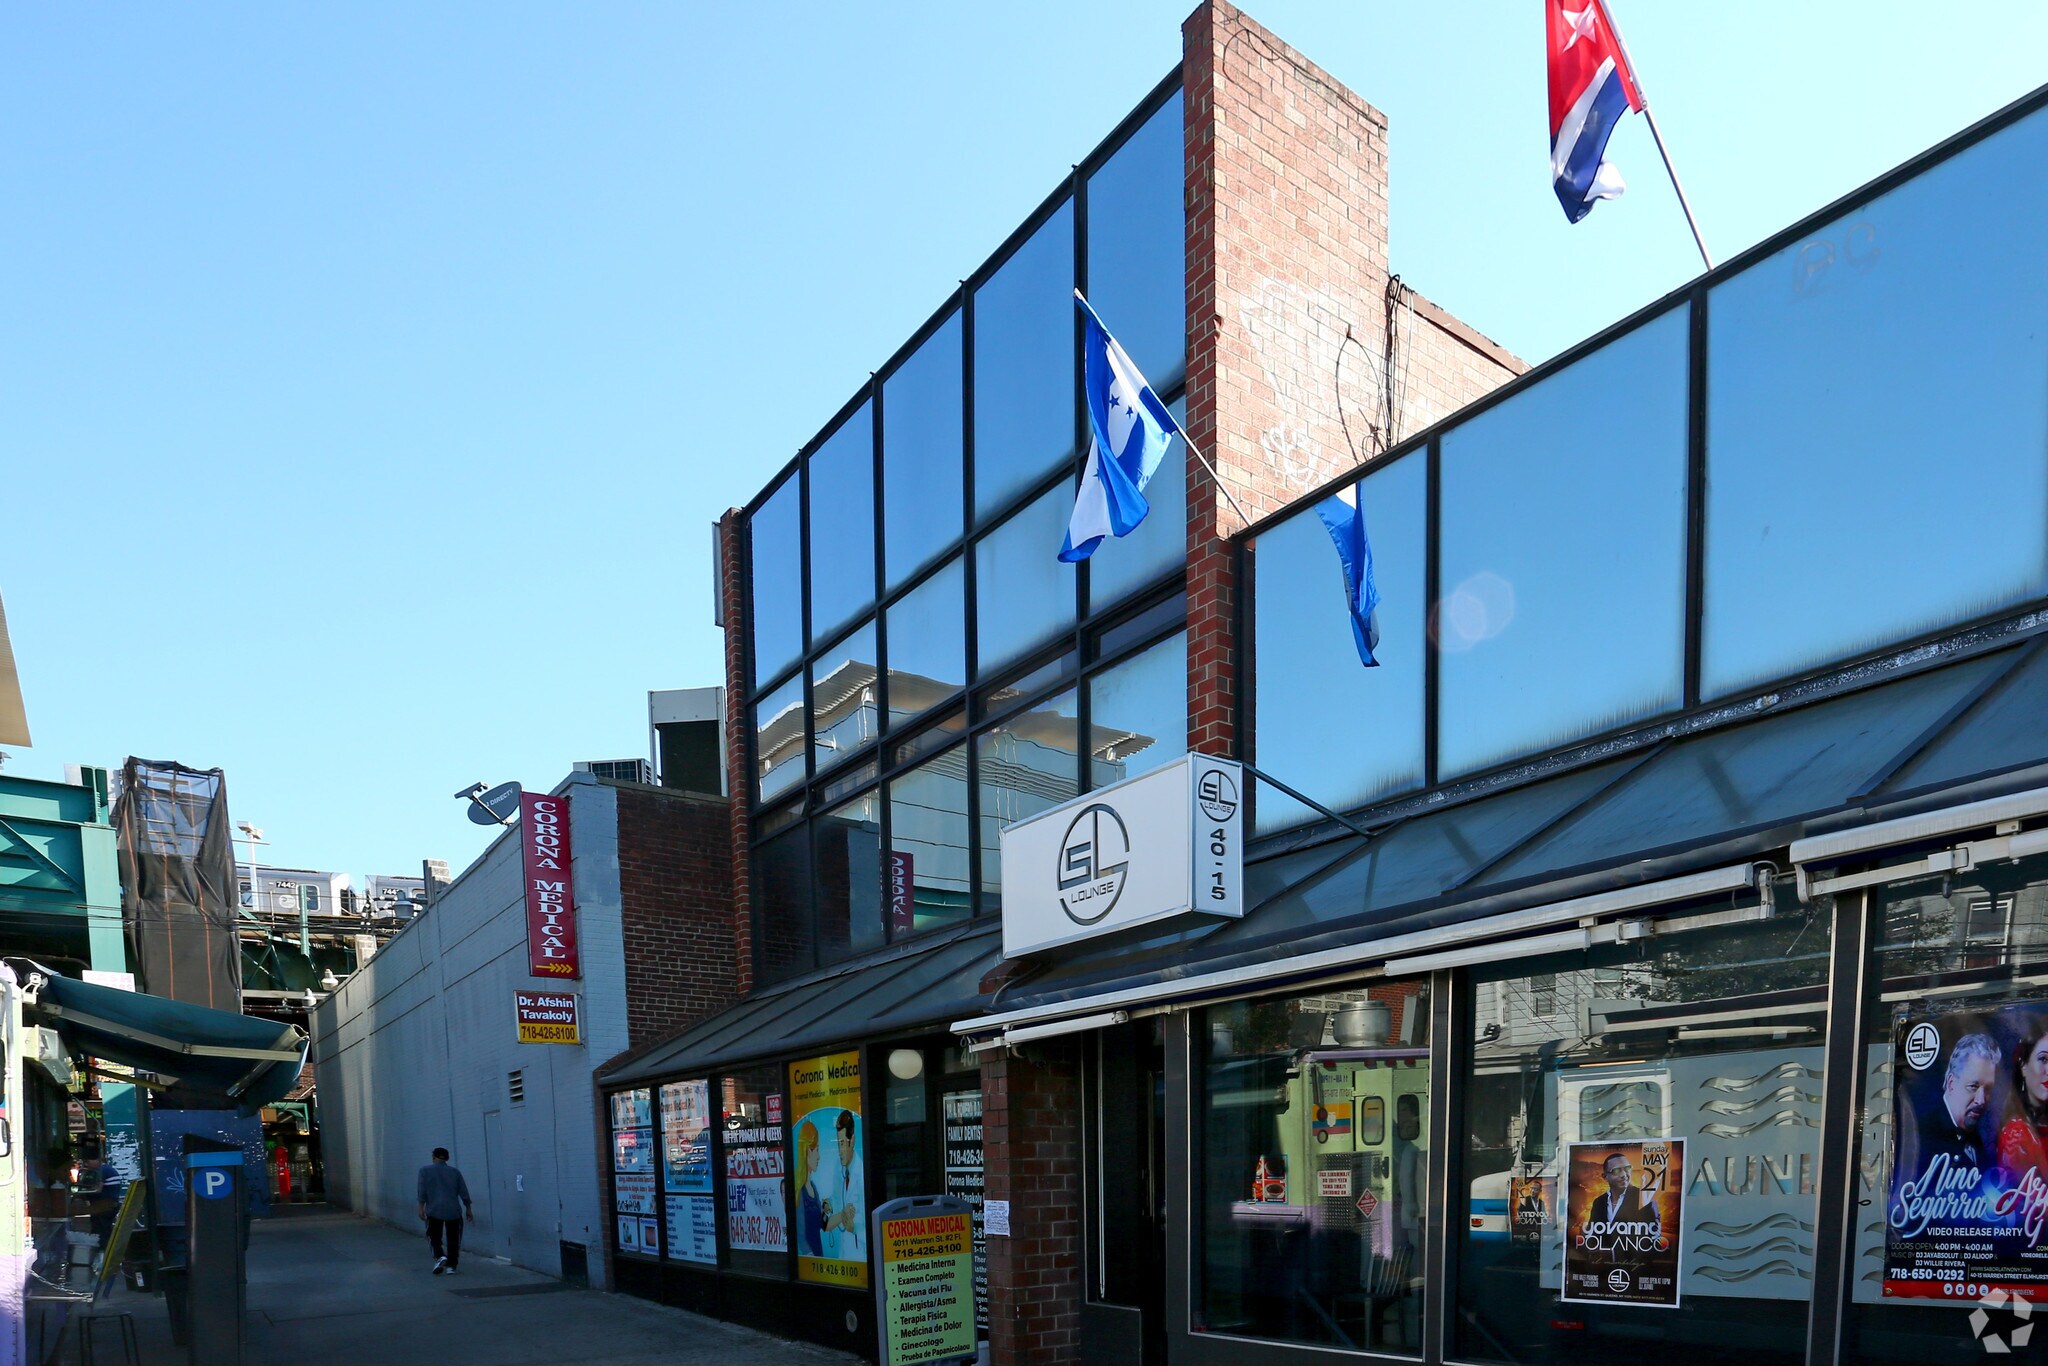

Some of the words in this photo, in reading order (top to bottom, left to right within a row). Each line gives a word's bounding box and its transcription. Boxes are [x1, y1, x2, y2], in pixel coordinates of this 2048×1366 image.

[1204, 802, 1232, 814] LOUNGE
[534, 801, 561, 869] CORONA
[1210, 828, 1227, 901] 40-15
[277, 881, 296, 889] 7442
[1071, 881, 1114, 904] LOUNGE
[534, 879, 566, 959] MEDICAL
[519, 996, 535, 1006] Dr.
[538, 997, 573, 1008] Afshin
[521, 1009, 573, 1023] Tavakoly
[521, 1025, 576, 1041] 718-426-8100
[795, 1069, 824, 1084] Corona
[828, 1059, 861, 1079] Medical
[1643, 1146, 1669, 1155] sunday
[1643, 1153, 1670, 1166] MAY
[1640, 1167, 1667, 1191] 21
[1915, 1153, 1982, 1197] Nino
[206, 1171, 226, 1196] P
[1890, 1181, 1988, 1238] Segarra
[888, 1219, 926, 1239] CORONA
[927, 1216, 966, 1234] MEDICAL
[1582, 1221, 1662, 1240] yovanny
[1927, 1227, 1953, 1237] VIDEO
[1953, 1227, 1992, 1237] RELEASE
[1993, 1227, 2023, 1237] PARTY
[893, 1239, 909, 1248] 4011
[910, 1237, 935, 1246] Warren
[1575, 1235, 1670, 1252] POLANCO
[1891, 1242, 1914, 1251] DOORS
[1914, 1242, 1934, 1251] OPEN
[1934, 1243, 1949, 1251] 4:00
[1950, 1243, 1961, 1251] PM
[1965, 1243, 1981, 1251] 4:00
[1981, 1243, 1993, 1251] AM
[895, 1243, 962, 1259] 718-426-8100
[1963, 1252, 1971, 1260] DJ
[812, 1263, 859, 1278] 718-426-8100
[897, 1261, 930, 1274] Medicina
[930, 1258, 956, 1269] Interna
[1915, 1259, 1923, 1267] DJ
[1923, 1259, 1943, 1267] WILLIE
[1944, 1259, 1966, 1268] RIVERA
[898, 1275, 924, 1286] Examen
[924, 1270, 955, 1284] Completo
[1890, 1267, 1965, 1281] 718-650-0292
[899, 1289, 927, 1299] Vacuna
[928, 1285, 939, 1295] del
[940, 1283, 952, 1293] Flu
[900, 1297, 957, 1312] Allergista/Asma
[900, 1313, 926, 1326] Terapia
[900, 1326, 933, 1339] Medicina
[933, 1323, 943, 1332] de
[943, 1320, 963, 1331] Dolor
[902, 1337, 944, 1351] Ginecologo
[902, 1351, 923, 1362] Prueba
[924, 1349, 931, 1358] de
[931, 1343, 971, 1358] Papanicolaou
